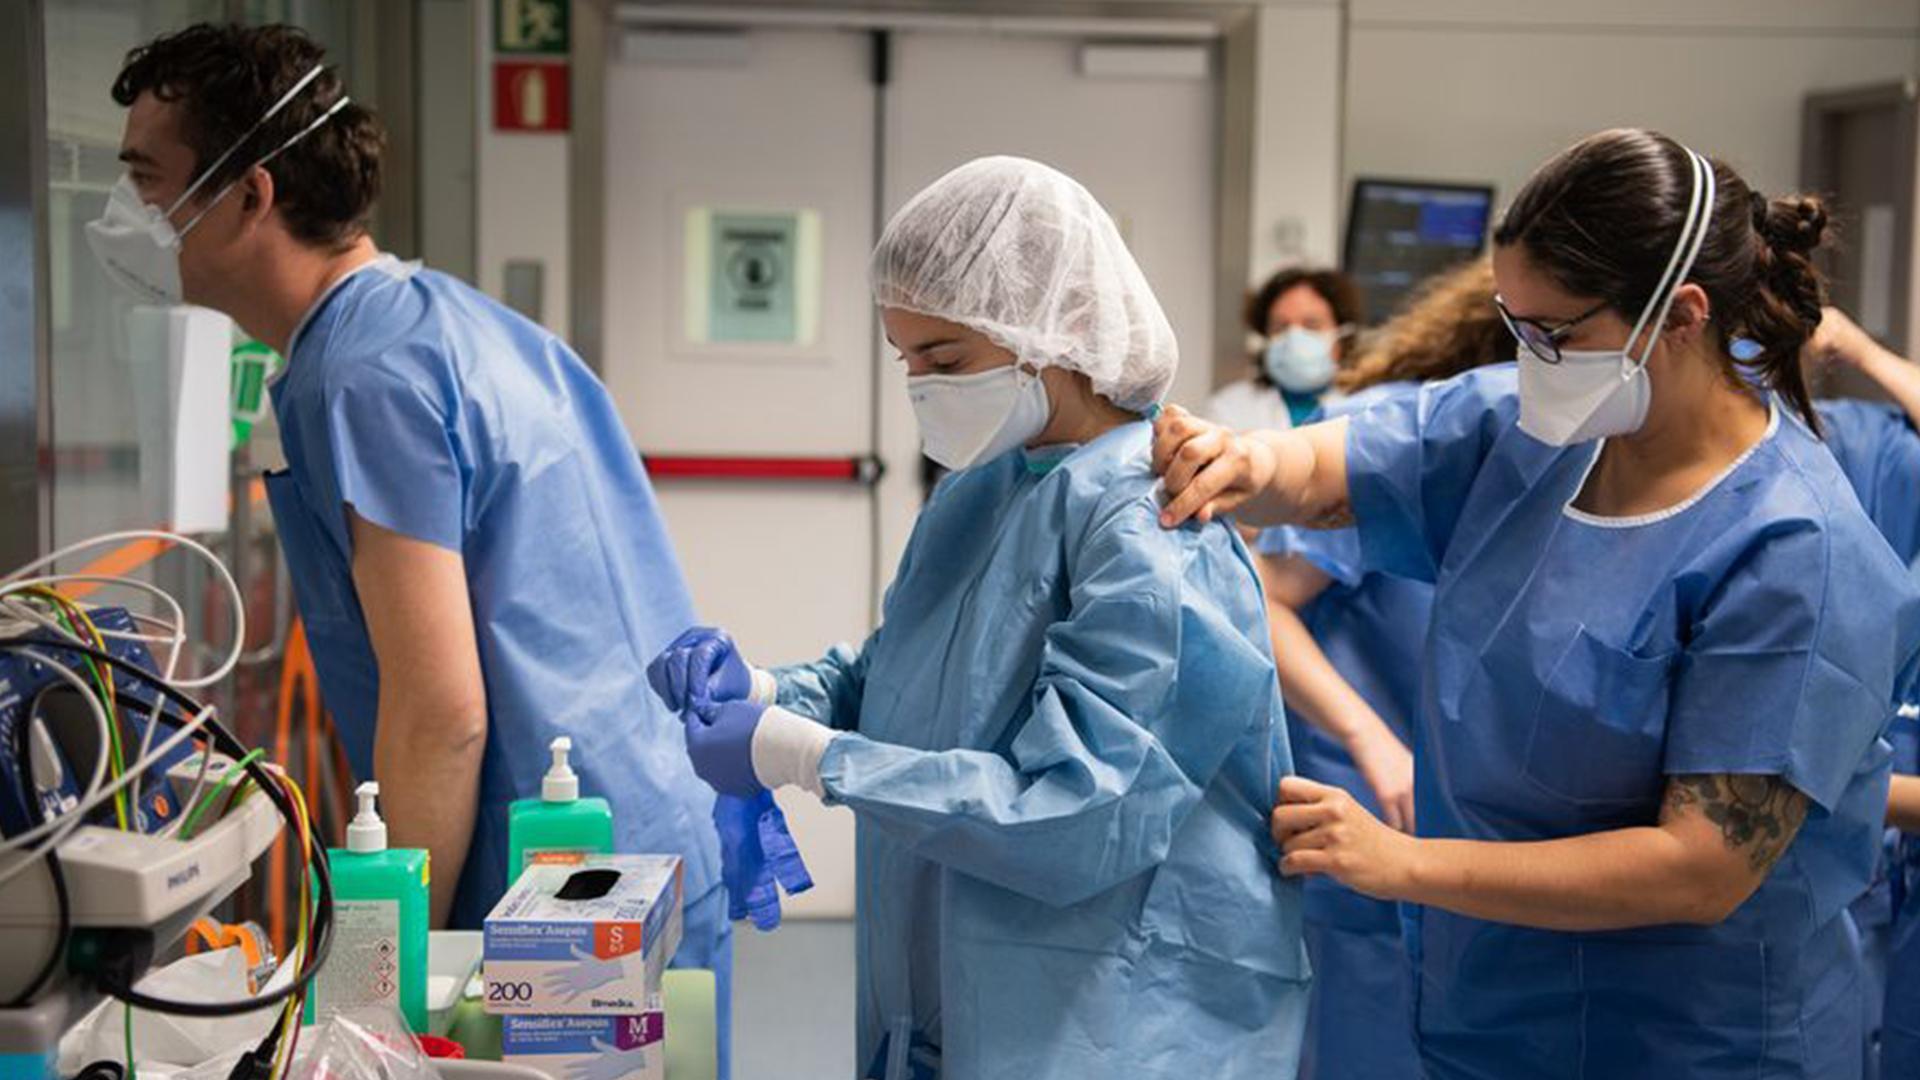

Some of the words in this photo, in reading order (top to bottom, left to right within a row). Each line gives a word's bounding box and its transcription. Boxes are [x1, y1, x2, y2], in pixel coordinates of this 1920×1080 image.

[610, 926, 624, 942] S
[490, 982, 532, 1001] 200
[628, 1017, 649, 1035] M
